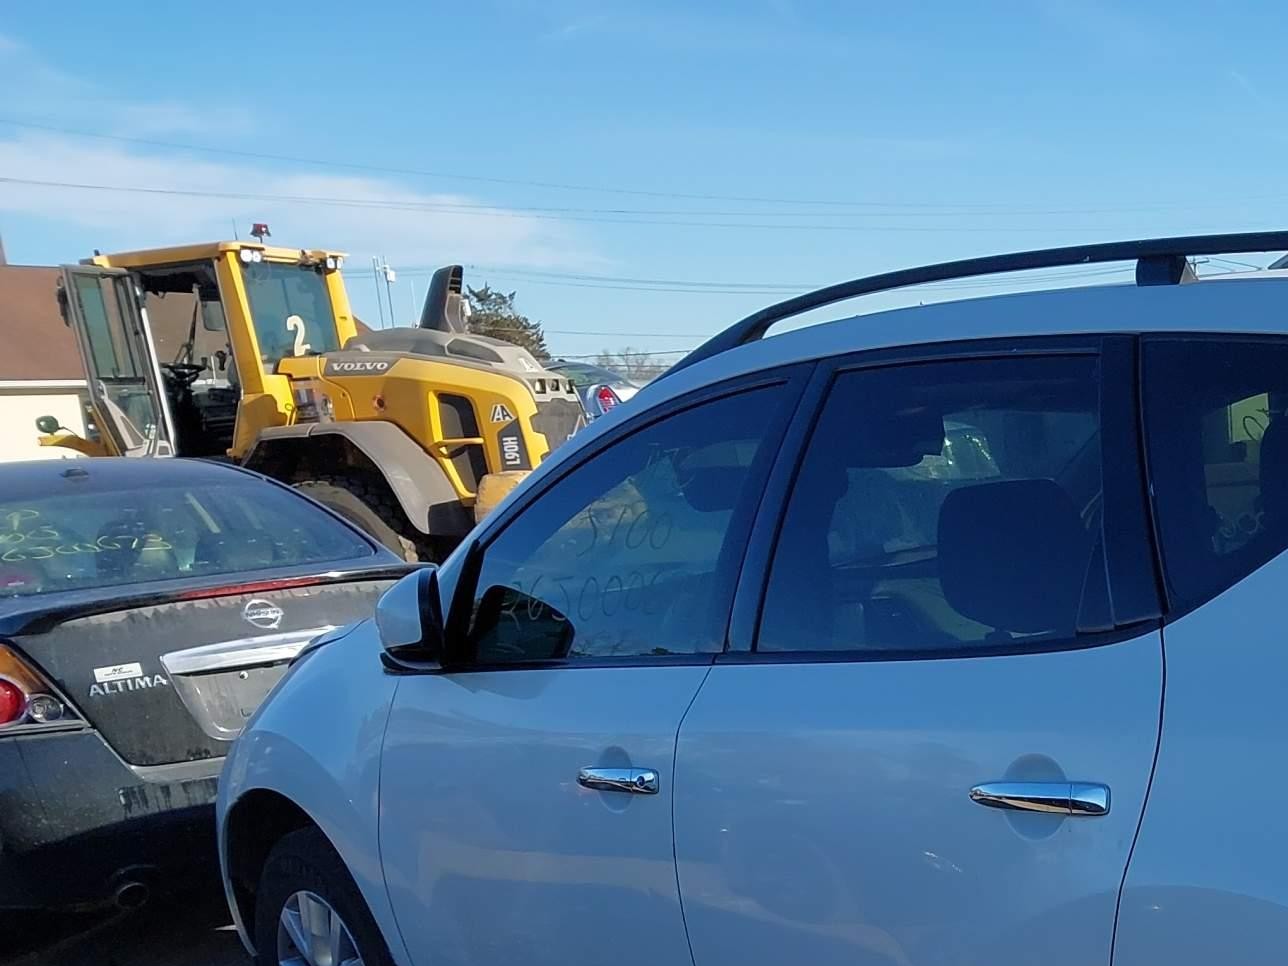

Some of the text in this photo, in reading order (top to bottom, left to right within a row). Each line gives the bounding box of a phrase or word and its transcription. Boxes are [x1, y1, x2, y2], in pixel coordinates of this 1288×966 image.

[286, 315, 311, 357] 2
[331, 361, 389, 371] VOLVO
[502, 436, 521, 465] L90H
[89, 674, 168, 697] ALTIMA
